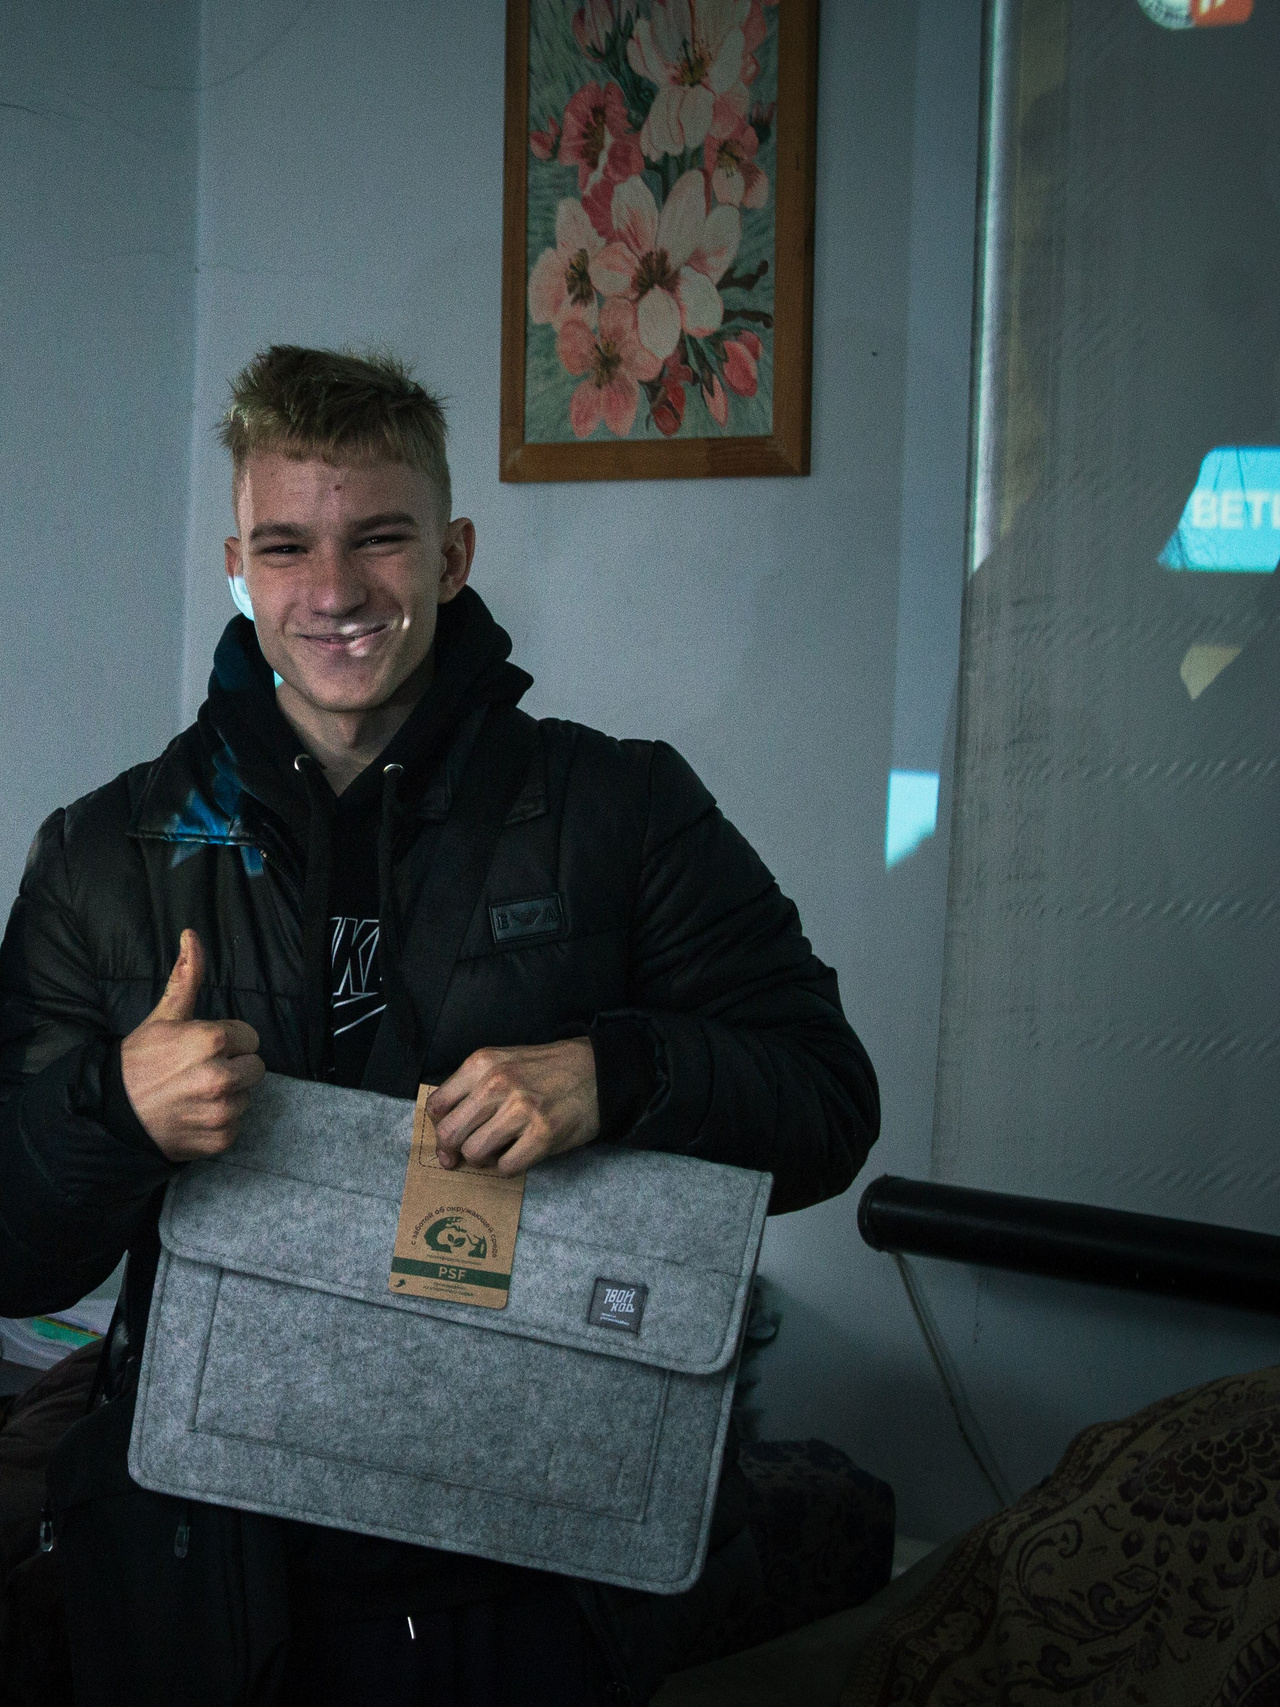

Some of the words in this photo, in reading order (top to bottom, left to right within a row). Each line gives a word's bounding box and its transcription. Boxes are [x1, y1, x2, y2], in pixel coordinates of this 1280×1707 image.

[412, 1212, 435, 1240] заботой
[434, 1206, 446, 1215] об
[446, 1206, 495, 1234] окружающей
[490, 1233, 499, 1259] среде
[438, 1266, 467, 1281] PSF
[603, 1288, 636, 1305] ТВОЙ
[610, 1302, 635, 1313] ХОД
